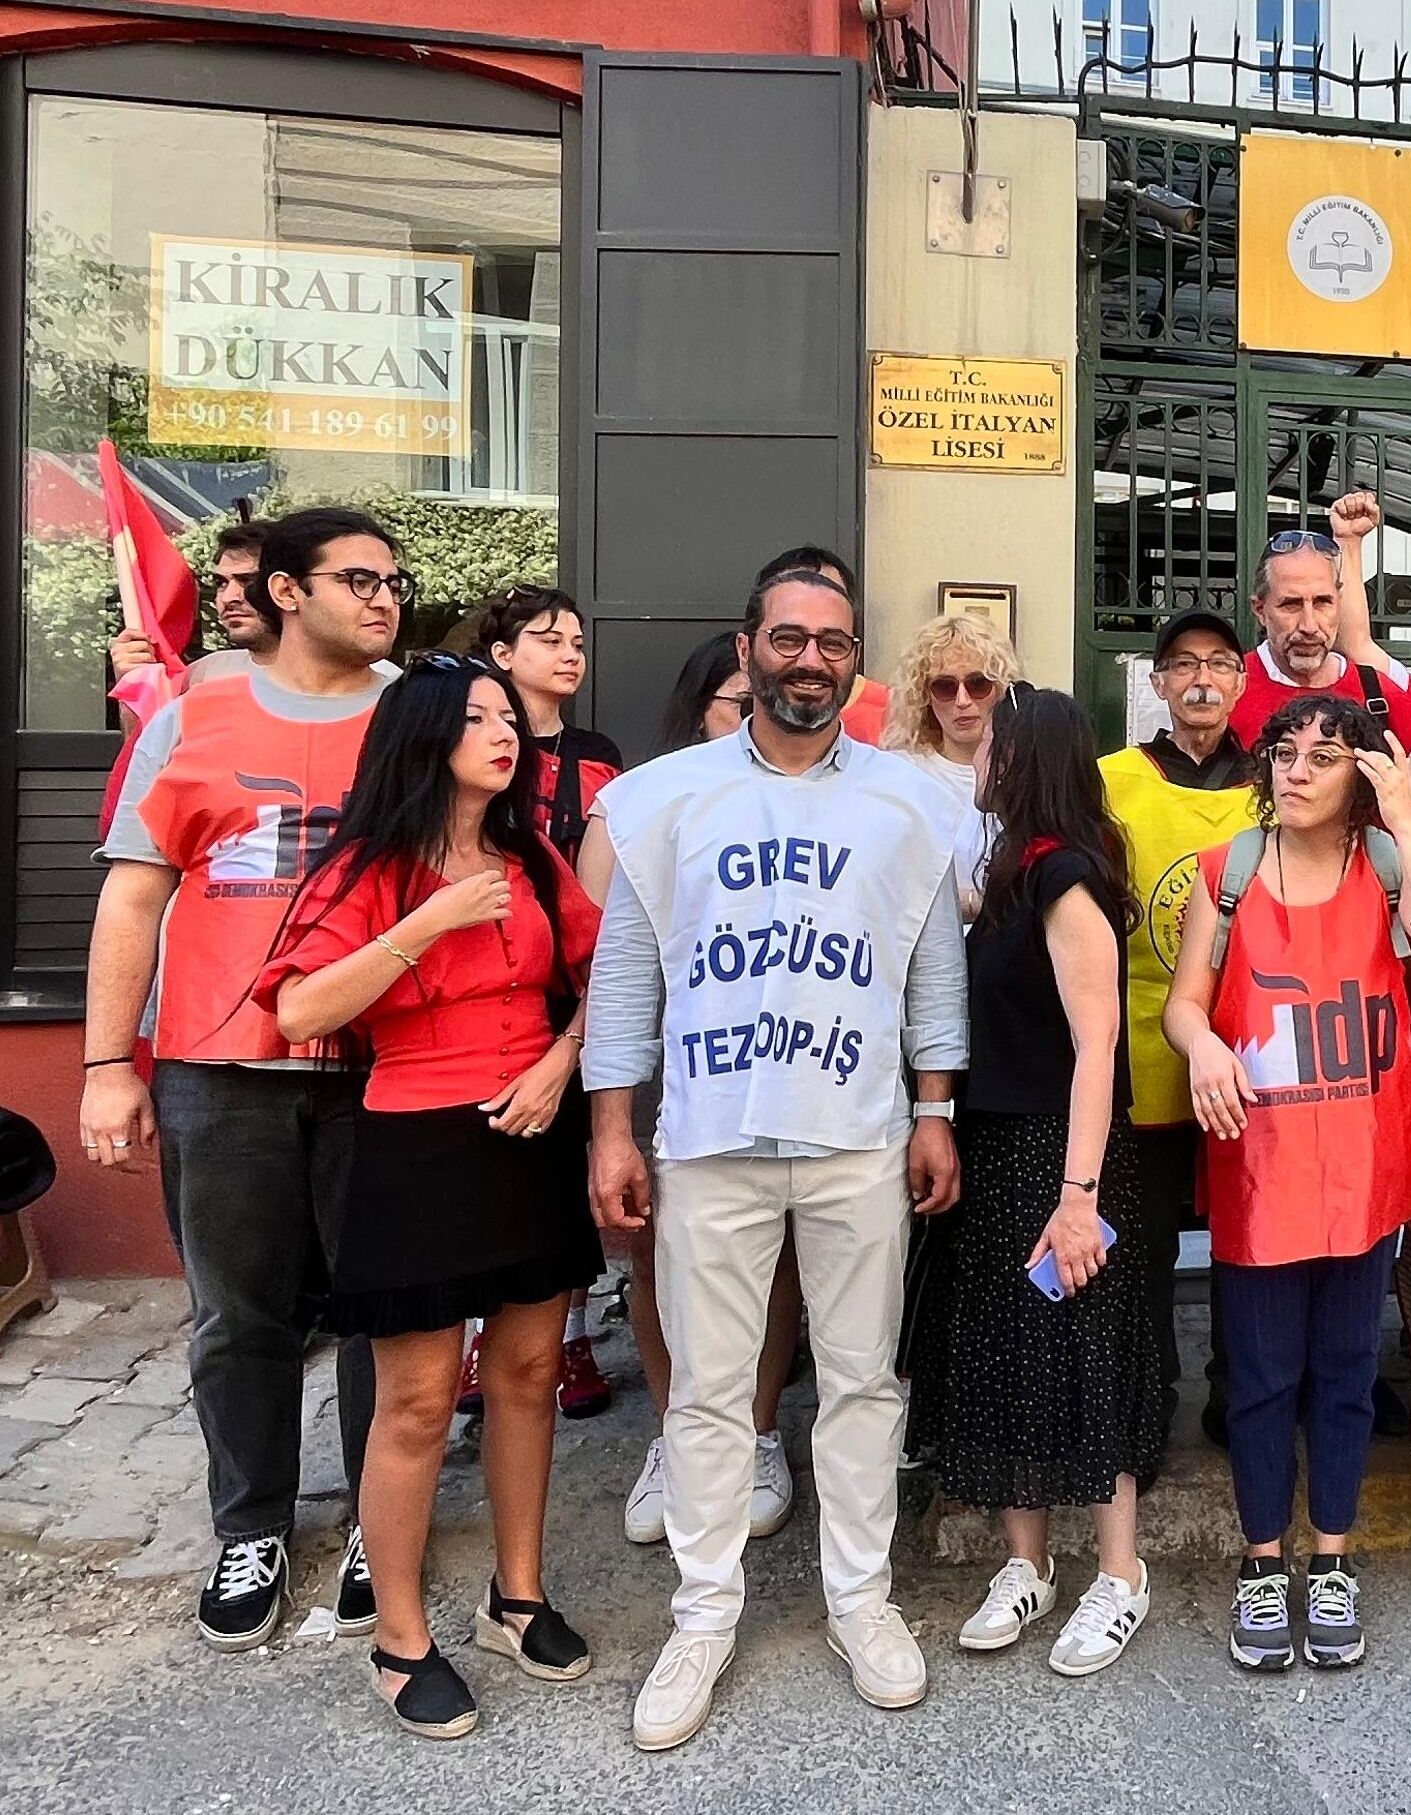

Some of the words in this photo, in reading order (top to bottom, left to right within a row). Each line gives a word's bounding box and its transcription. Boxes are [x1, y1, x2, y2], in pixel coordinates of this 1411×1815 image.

[174, 252, 456, 320] KİRALIK
[174, 326, 453, 392] DÜKKAN
[949, 370, 987, 387] T.C.
[880, 386, 920, 402] MİLLİ
[925, 387, 976, 404] EĞİTİM
[981, 392, 1055, 408] BAKANLIĞI
[164, 400, 226, 429] +90
[238, 405, 293, 434] 541
[308, 410, 362, 438] 189
[374, 412, 408, 440] 61
[421, 414, 458, 441] 99
[877, 405, 944, 429] ÖZEL
[951, 409, 1057, 435] İTALYAN
[931, 436, 1006, 460] LİSESİ
[1024, 452, 1046, 461] 1888
[717, 837, 852, 891] GREV
